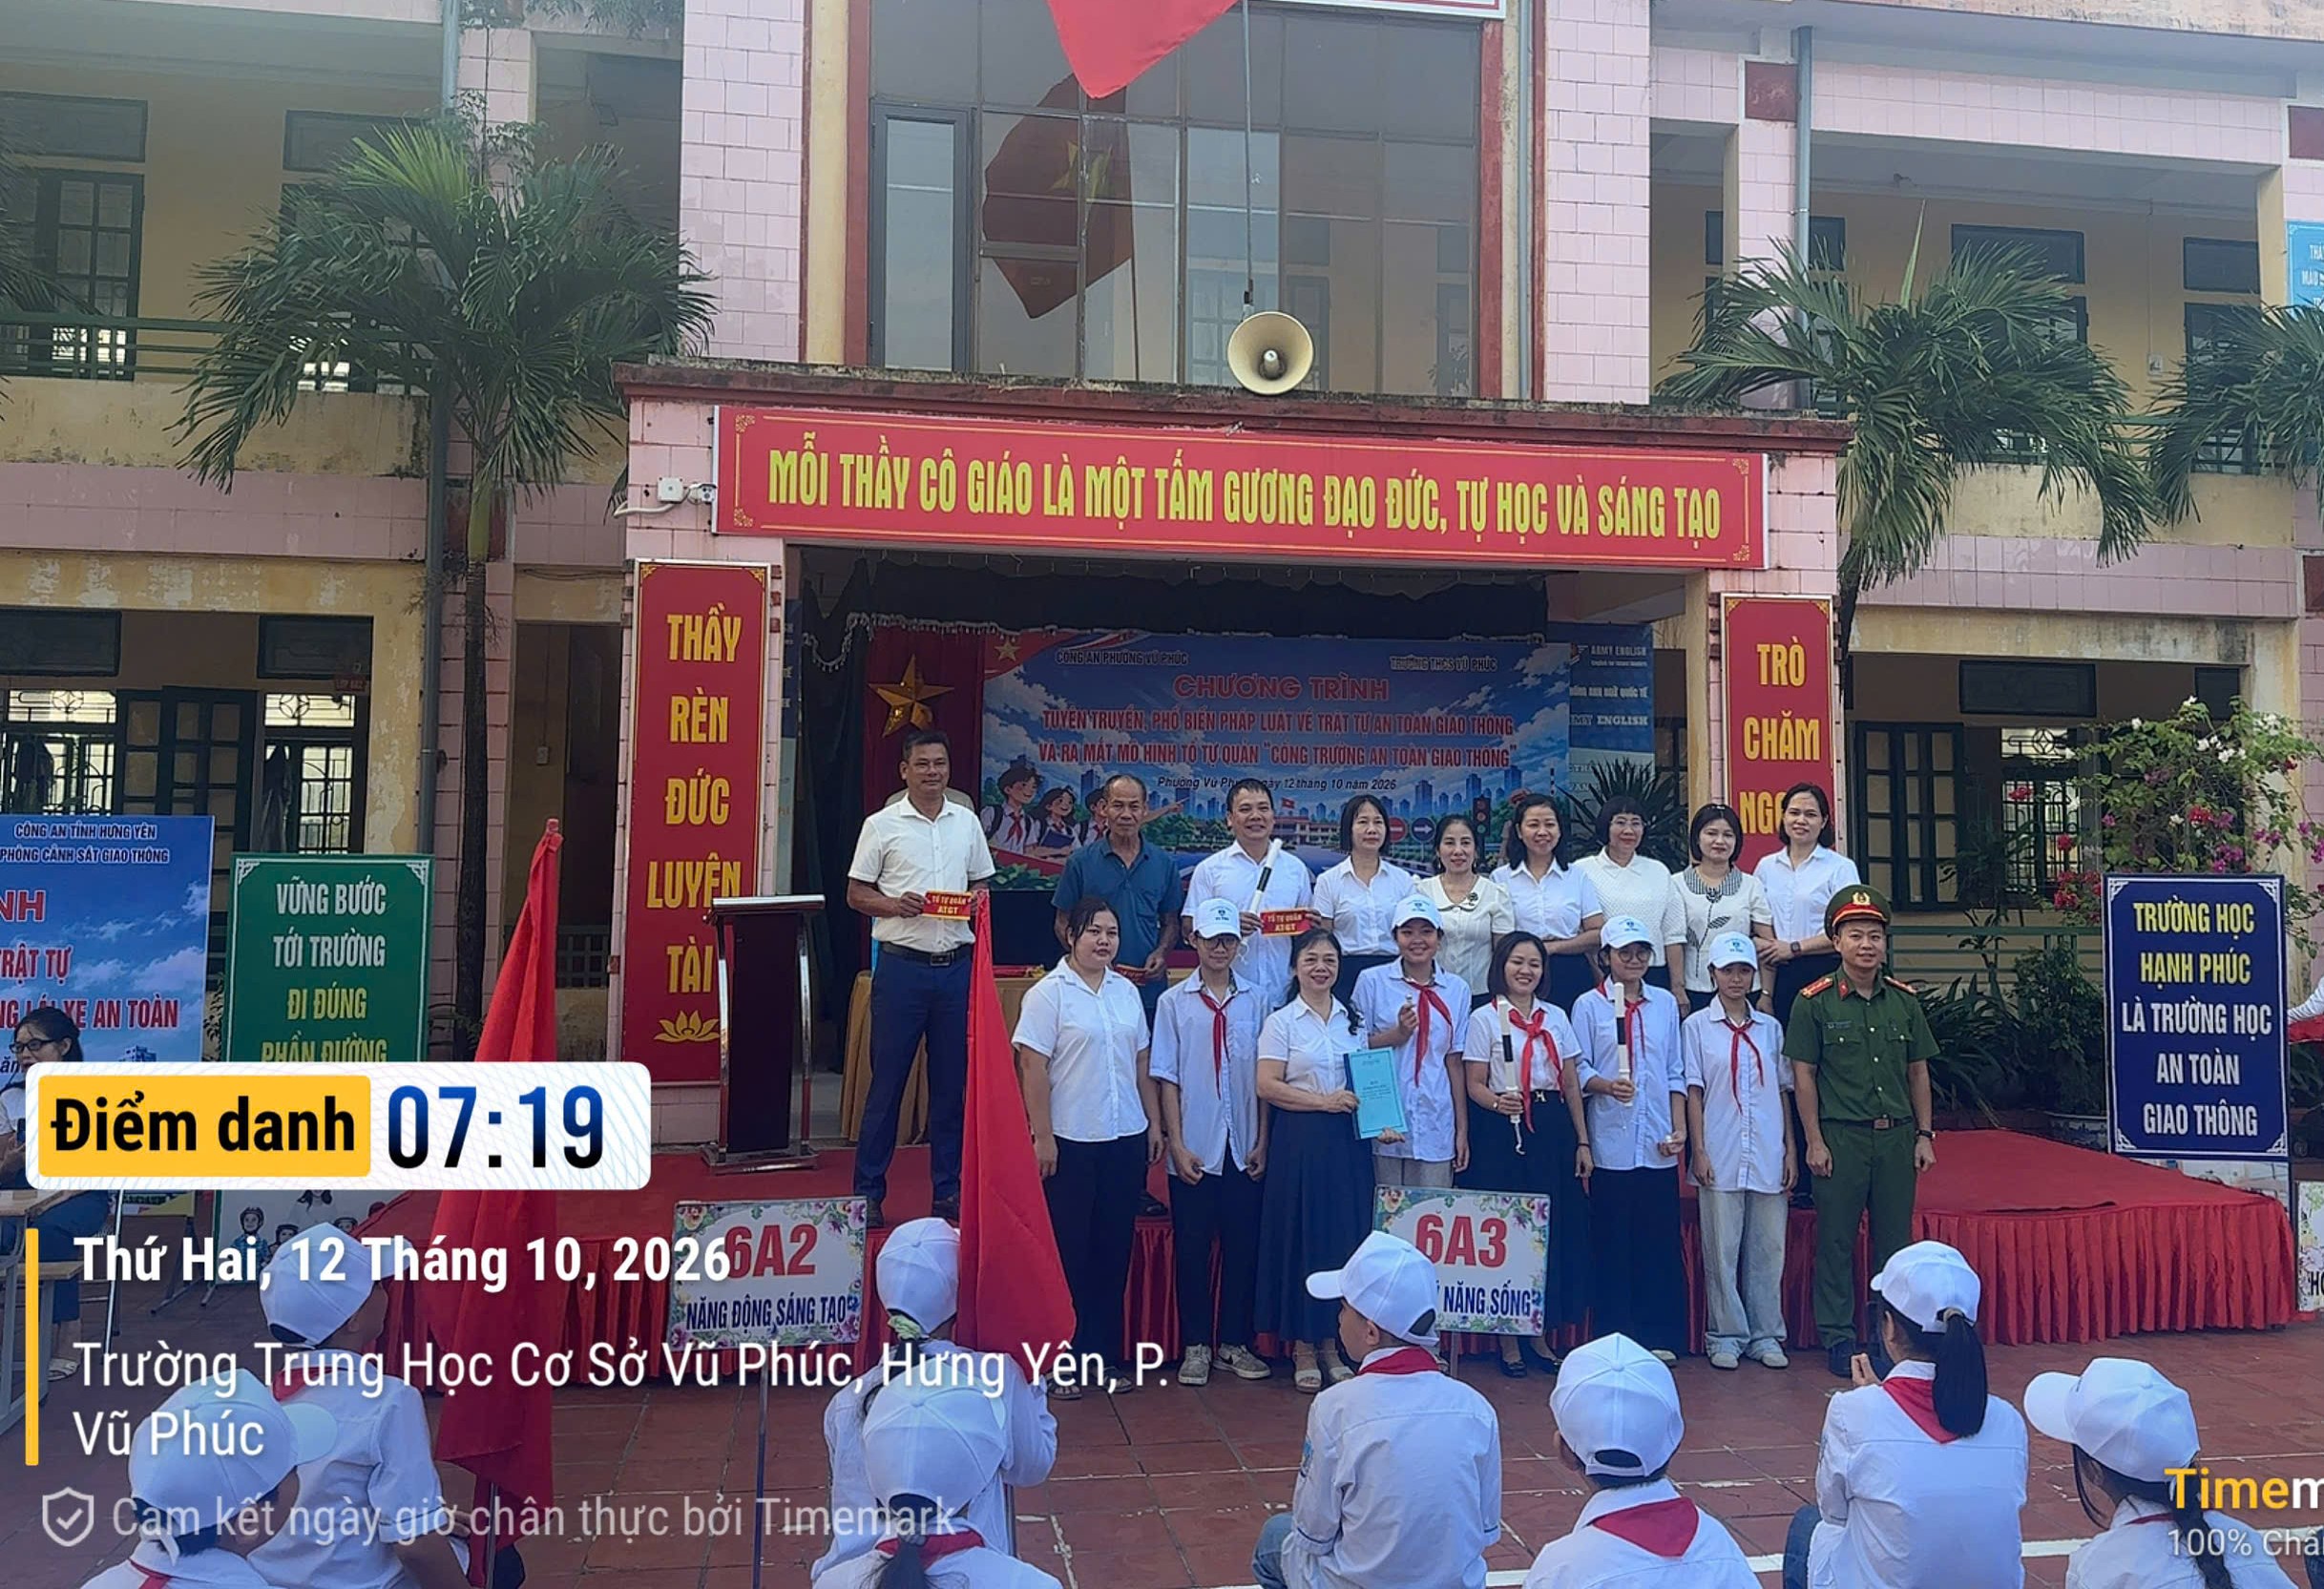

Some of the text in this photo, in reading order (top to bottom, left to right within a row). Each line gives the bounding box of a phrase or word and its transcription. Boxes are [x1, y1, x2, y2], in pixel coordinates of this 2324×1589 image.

[768, 431, 1720, 549] MỖI THẦY CÔ GIÁO LÀ MỘT TẤM GƯƠNG ĐẠO ĐỨC, TỰ HỌC VÀ SÁNG TẠO
[667, 602, 742, 663] THẦY
[1057, 649, 1083, 665] CÔNG
[1086, 651, 1100, 665] AN
[1103, 649, 1144, 666] PHƯỜNG
[1756, 636, 1806, 687] TRÒ
[1174, 671, 1390, 701] CHƯƠNG TRÌNH
[670, 687, 728, 742] RÈN
[1043, 705, 1086, 731] TUYÊN
[1152, 704, 1181, 731] PHỔ
[1184, 705, 1215, 732] BIẾN
[1221, 708, 1256, 732] PHÁP
[1261, 709, 1291, 736] LUẬT
[1297, 706, 1313, 733] VỀ
[1318, 710, 1349, 736] TRẬT
[1353, 712, 1372, 737] TỰ
[1374, 714, 1392, 734] AN
[1397, 712, 1431, 735] TOÀN
[1435, 716, 1465, 735] GIAO
[1472, 714, 1513, 736] THÔNG
[1039, 739, 1057, 762] VÀ
[1061, 744, 1078, 763] RA
[1084, 737, 1112, 763] MẮT
[1118, 739, 1139, 763] MÔ
[1143, 740, 1176, 763] HÌNH
[1182, 737, 1197, 763] TỔ
[1203, 742, 1219, 767] TỰ
[1223, 741, 1258, 764] QUẢN
[1313, 742, 1365, 765] TRƯỜNG
[1370, 747, 1388, 766] AN
[1392, 743, 1426, 767] TOÀN
[1432, 748, 1461, 767] GIAO
[1744, 710, 1821, 762] CHĂM
[664, 767, 730, 826] ĐỨC
[1158, 777, 1397, 792] Phường Vũ 12 tháng 10 năm 2026
[15, 820, 157, 841] CÔNG AN TỈNH HƯNG YÊN
[0, 844, 170, 864] PHÒNG CẢNH SÁT GIAO THÔNG
[276, 874, 387, 915] VỮNG BƯỚC
[2132, 894, 2254, 940] TRƯỜNG HỌC
[0, 943, 73, 984] RẬT TỰ
[273, 926, 386, 968] TỚI TRƯỜNG
[667, 936, 713, 993] TÀI
[2140, 947, 2251, 990] HẠNH PHÚC
[94, 999, 120, 1029] AN
[127, 993, 179, 1029] TOÀN
[287, 981, 367, 1020] ĐI ĐÚNG
[2122, 995, 2272, 1042] LÀ TRƯỜNG HỌC
[2157, 1047, 2241, 1086] AN TOÀN
[2143, 1098, 2258, 1138] GIAO THÔNG
[724, 1223, 818, 1279] 6A2
[1415, 1213, 1508, 1268] 6A3
[686, 1291, 847, 1334] NĂNG ĐỘNG SÁNG TẠO
[1444, 1281, 1486, 1314] NĂNG
[1490, 1280, 1531, 1316] SỐNG
